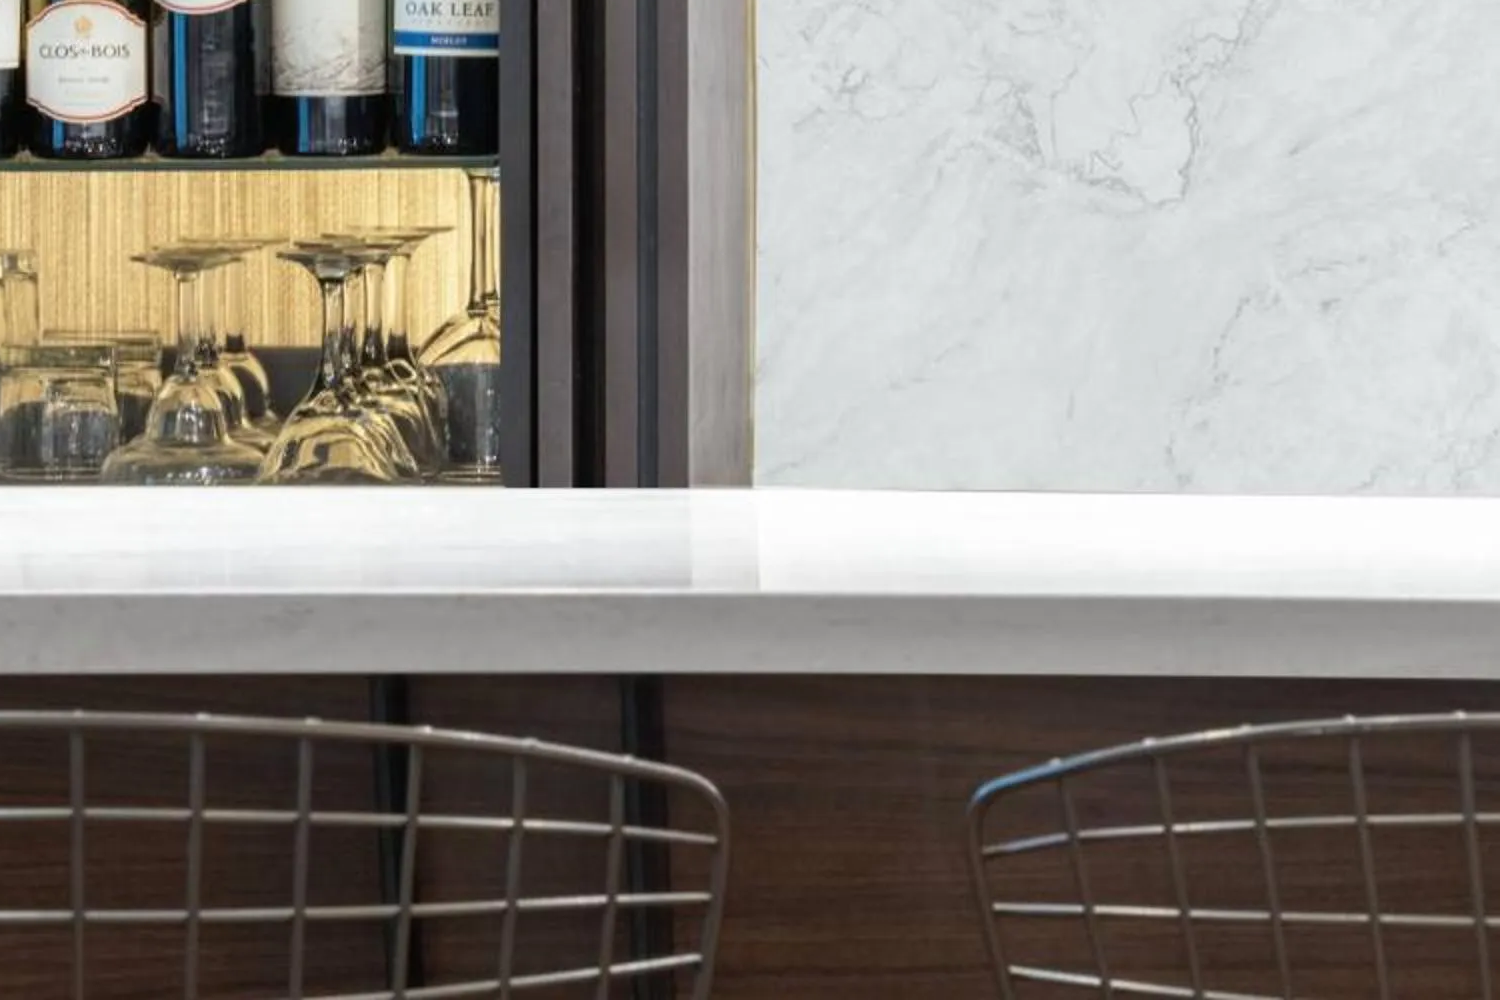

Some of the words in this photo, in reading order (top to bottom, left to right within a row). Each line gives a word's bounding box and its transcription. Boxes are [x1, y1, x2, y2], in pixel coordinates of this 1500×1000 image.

[405, 0, 443, 17] OAK
[451, 1, 495, 18] LEAF
[39, 43, 78, 60] CLOS
[91, 43, 131, 59] BOIS
